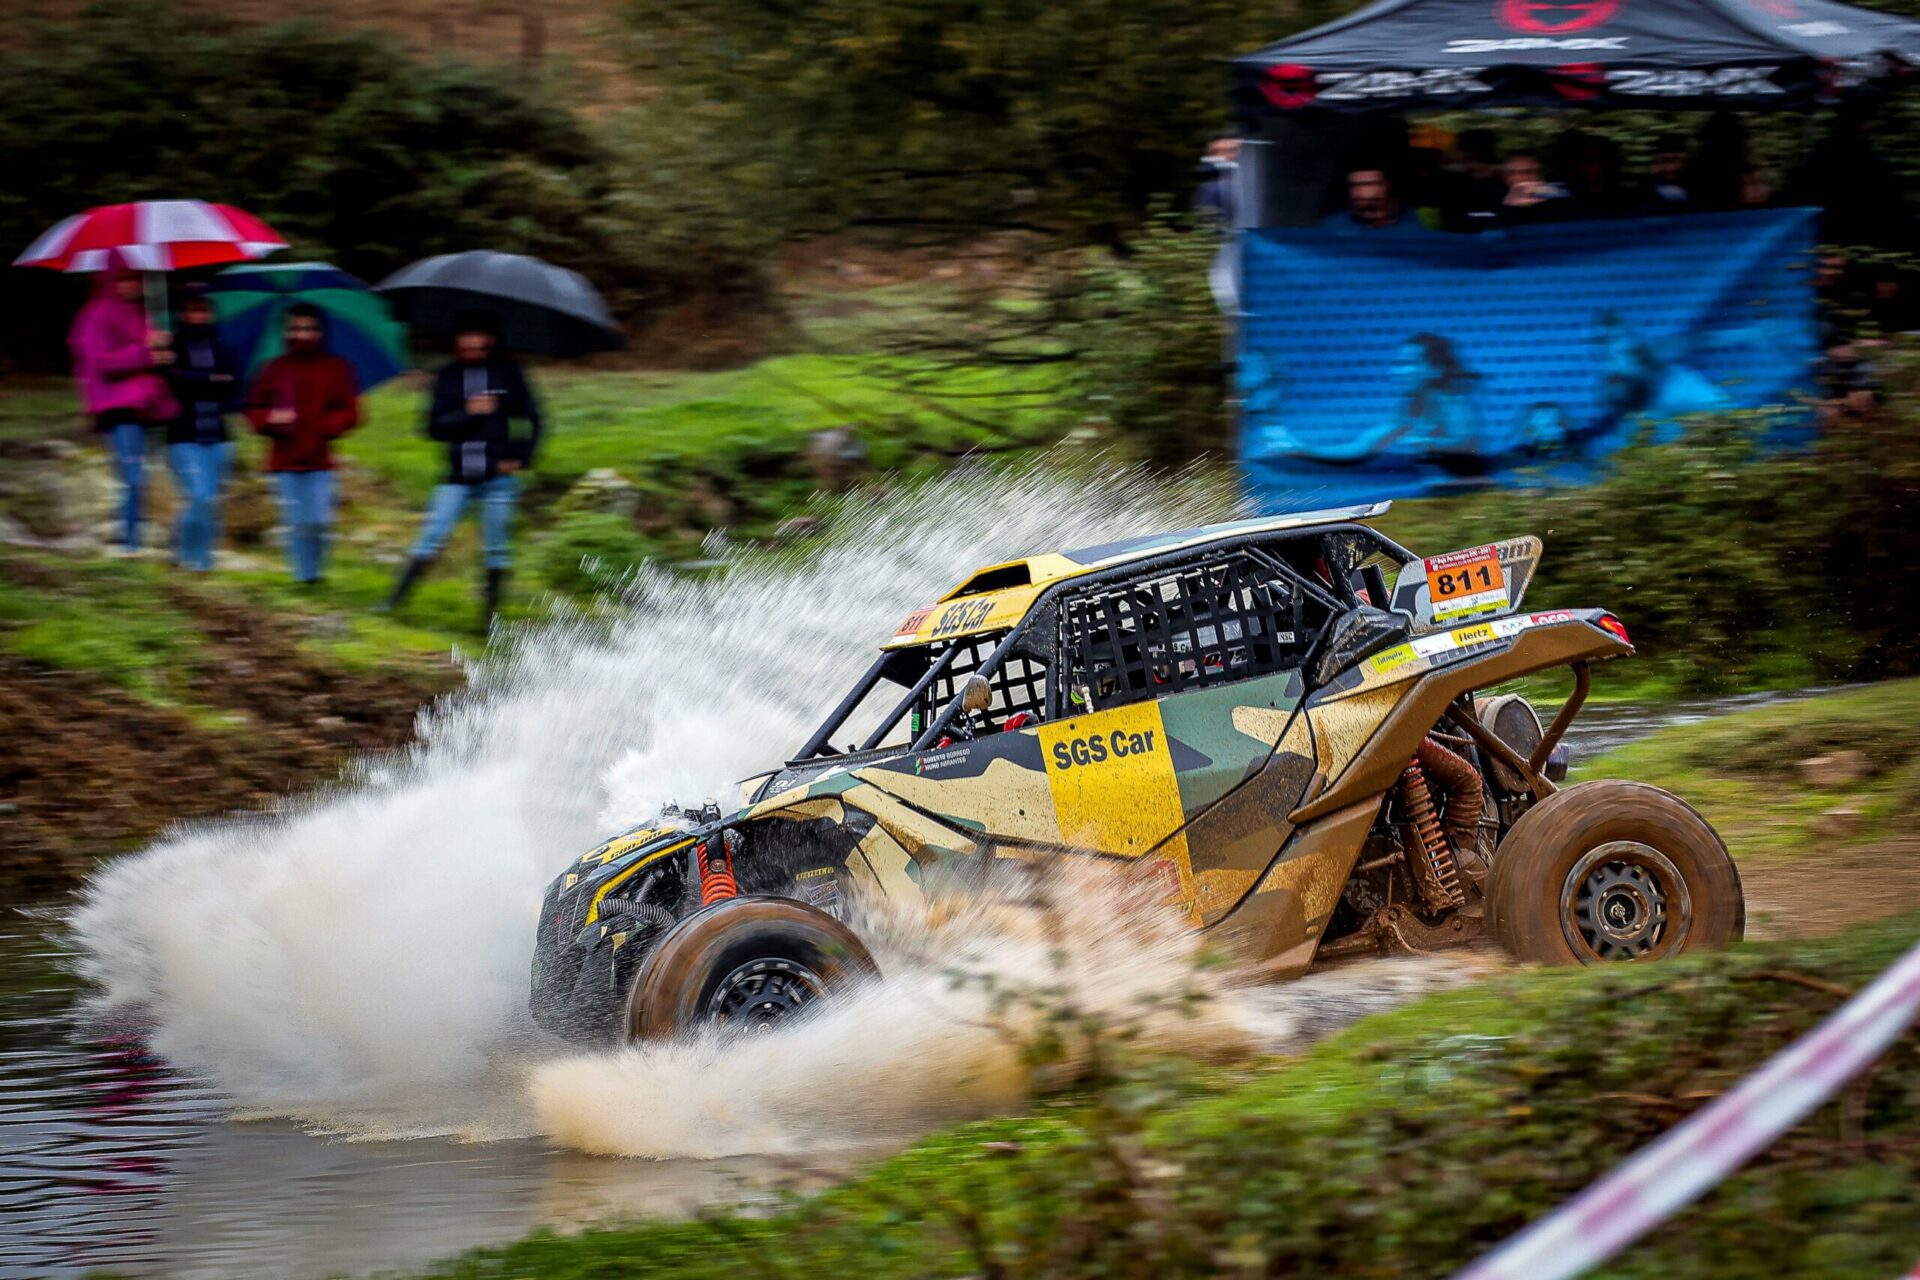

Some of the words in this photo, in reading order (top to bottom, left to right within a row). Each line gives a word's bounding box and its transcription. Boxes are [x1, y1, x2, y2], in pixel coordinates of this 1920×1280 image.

[1438, 565, 1492, 595] 811
[902, 615, 926, 632] 811
[932, 601, 976, 637] SGS
[965, 598, 997, 631] Car
[1459, 628, 1488, 642] Hertz
[1053, 735, 1108, 770] SGS
[1111, 730, 1154, 758] Car
